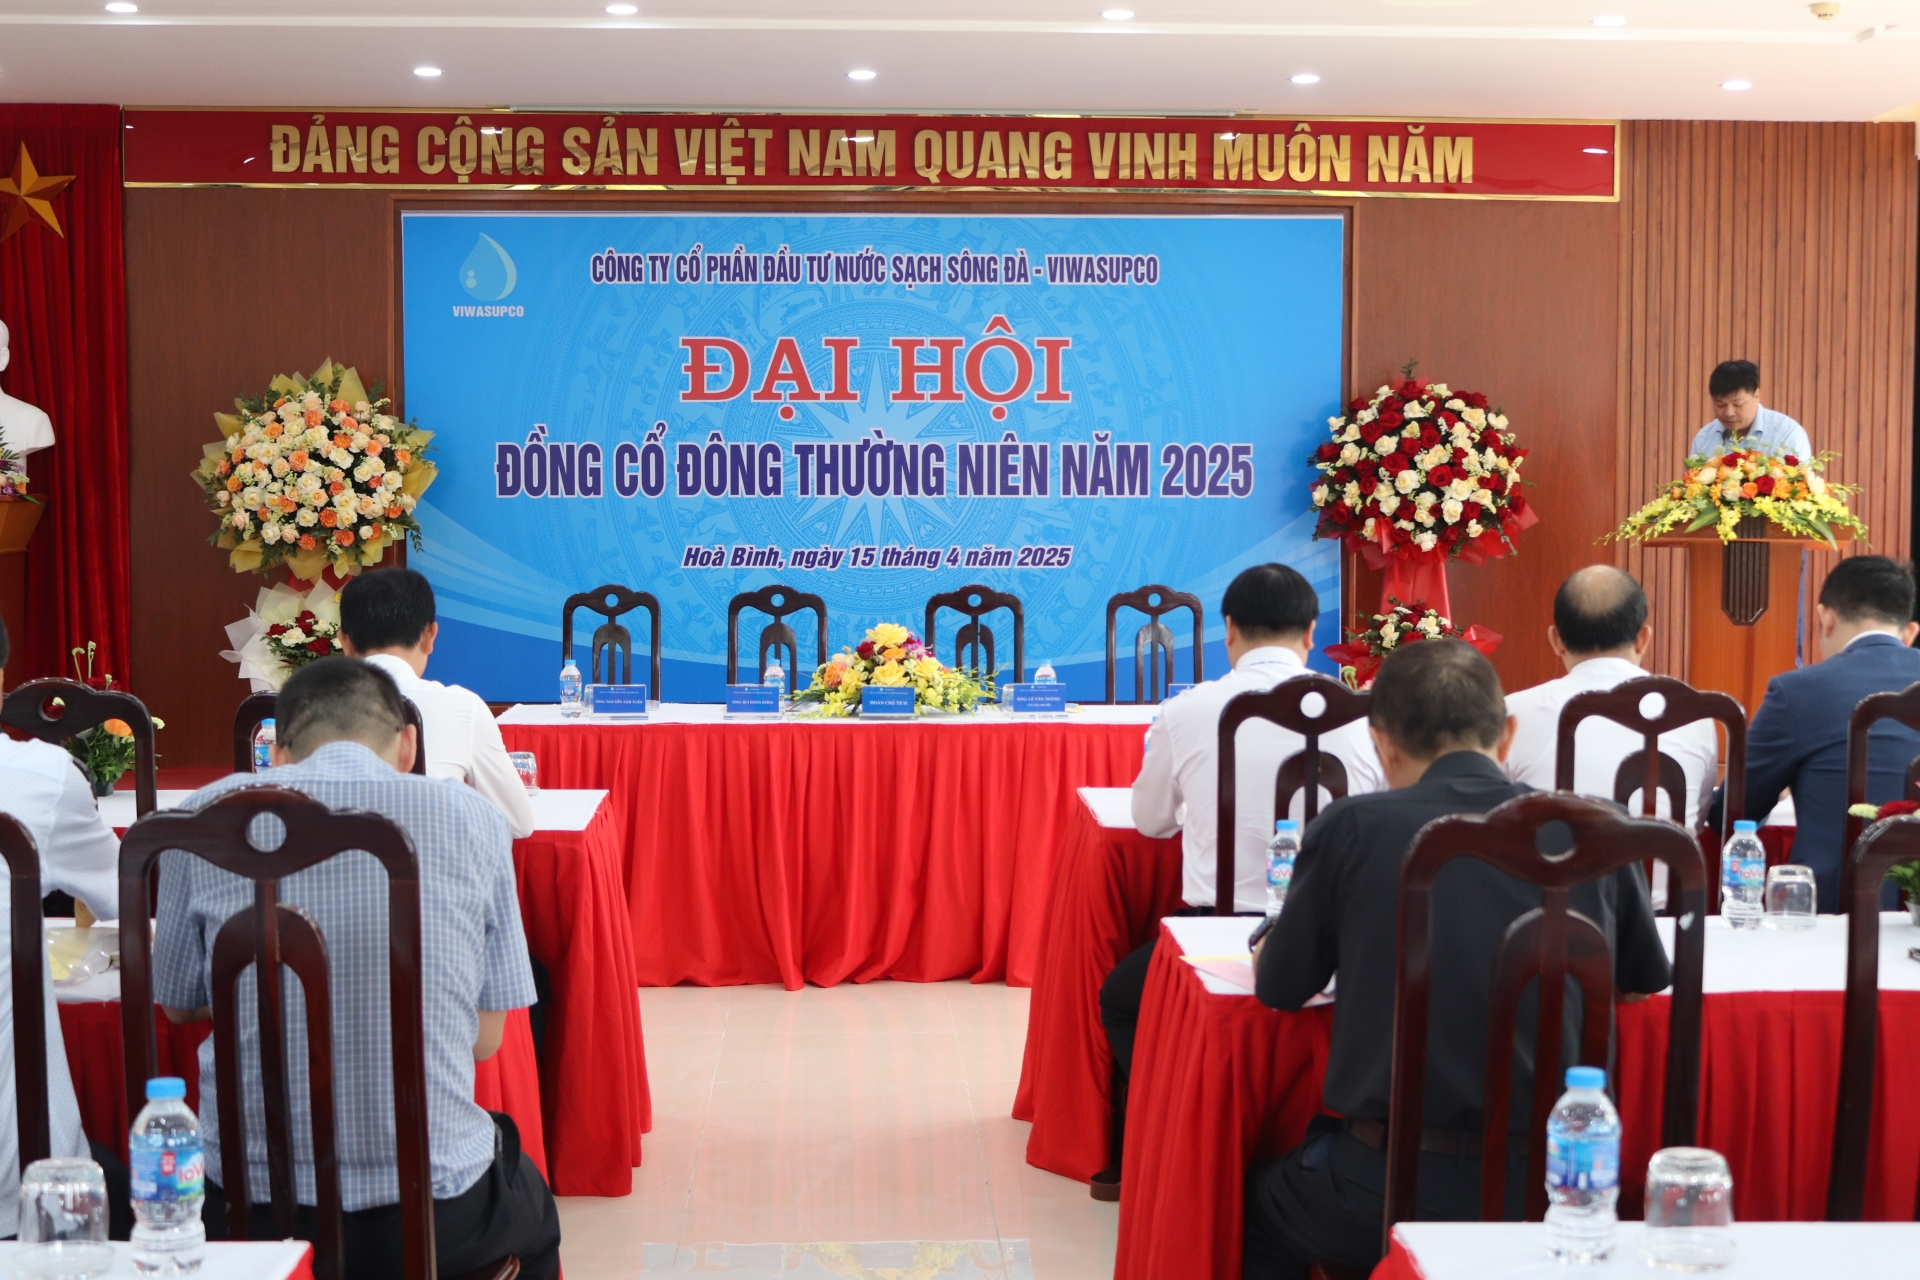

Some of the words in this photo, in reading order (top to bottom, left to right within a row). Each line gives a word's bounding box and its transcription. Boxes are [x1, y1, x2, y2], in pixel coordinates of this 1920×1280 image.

[270, 114, 400, 174] ĐẢNG
[417, 116, 545, 183] CỘNG
[562, 116, 658, 176] SẢN
[674, 117, 773, 184] VIỆT
[788, 129, 896, 177] NAM
[914, 130, 1072, 184] QUANG
[1088, 132, 1197, 180] VINH
[1213, 123, 1351, 182] MUÔN
[1367, 125, 1473, 183] NĂM
[591, 248, 643, 283] CÔNG
[648, 255, 671, 283] TY
[676, 244, 702, 283] CỔ
[706, 245, 758, 283] PHẦN
[762, 244, 801, 283] ĐẦU
[806, 252, 832, 283] TƯ
[835, 248, 887, 284] NƯỚC
[892, 255, 942, 289] SẠCH
[947, 250, 999, 284] SÔNG
[1003, 250, 1030, 284] ĐÀ
[1033, 267, 1043, 275] -
[1047, 255, 1159, 284] VIWASUPCO
[452, 305, 525, 318] VIWASUPCO
[680, 337, 859, 420] ĐẠI
[891, 314, 1071, 421] HỘI
[496, 425, 603, 497] ĐỒNG
[614, 422, 668, 497] CỔ
[676, 431, 783, 497] ĐÔNG
[794, 429, 945, 497] THƯỜNG
[957, 433, 1049, 497] NIÊN
[1062, 432, 1150, 497] NĂM
[1161, 443, 1253, 497] 2025
[683, 546, 725, 567] Hoà
[730, 545, 785, 569] Bình,
[790, 545, 844, 569] ngày
[851, 546, 876, 567] 15
[880, 545, 941, 569] tháng
[945, 547, 960, 567] 4
[964, 545, 1013, 567] năm
[1017, 546, 1072, 567] 2025
